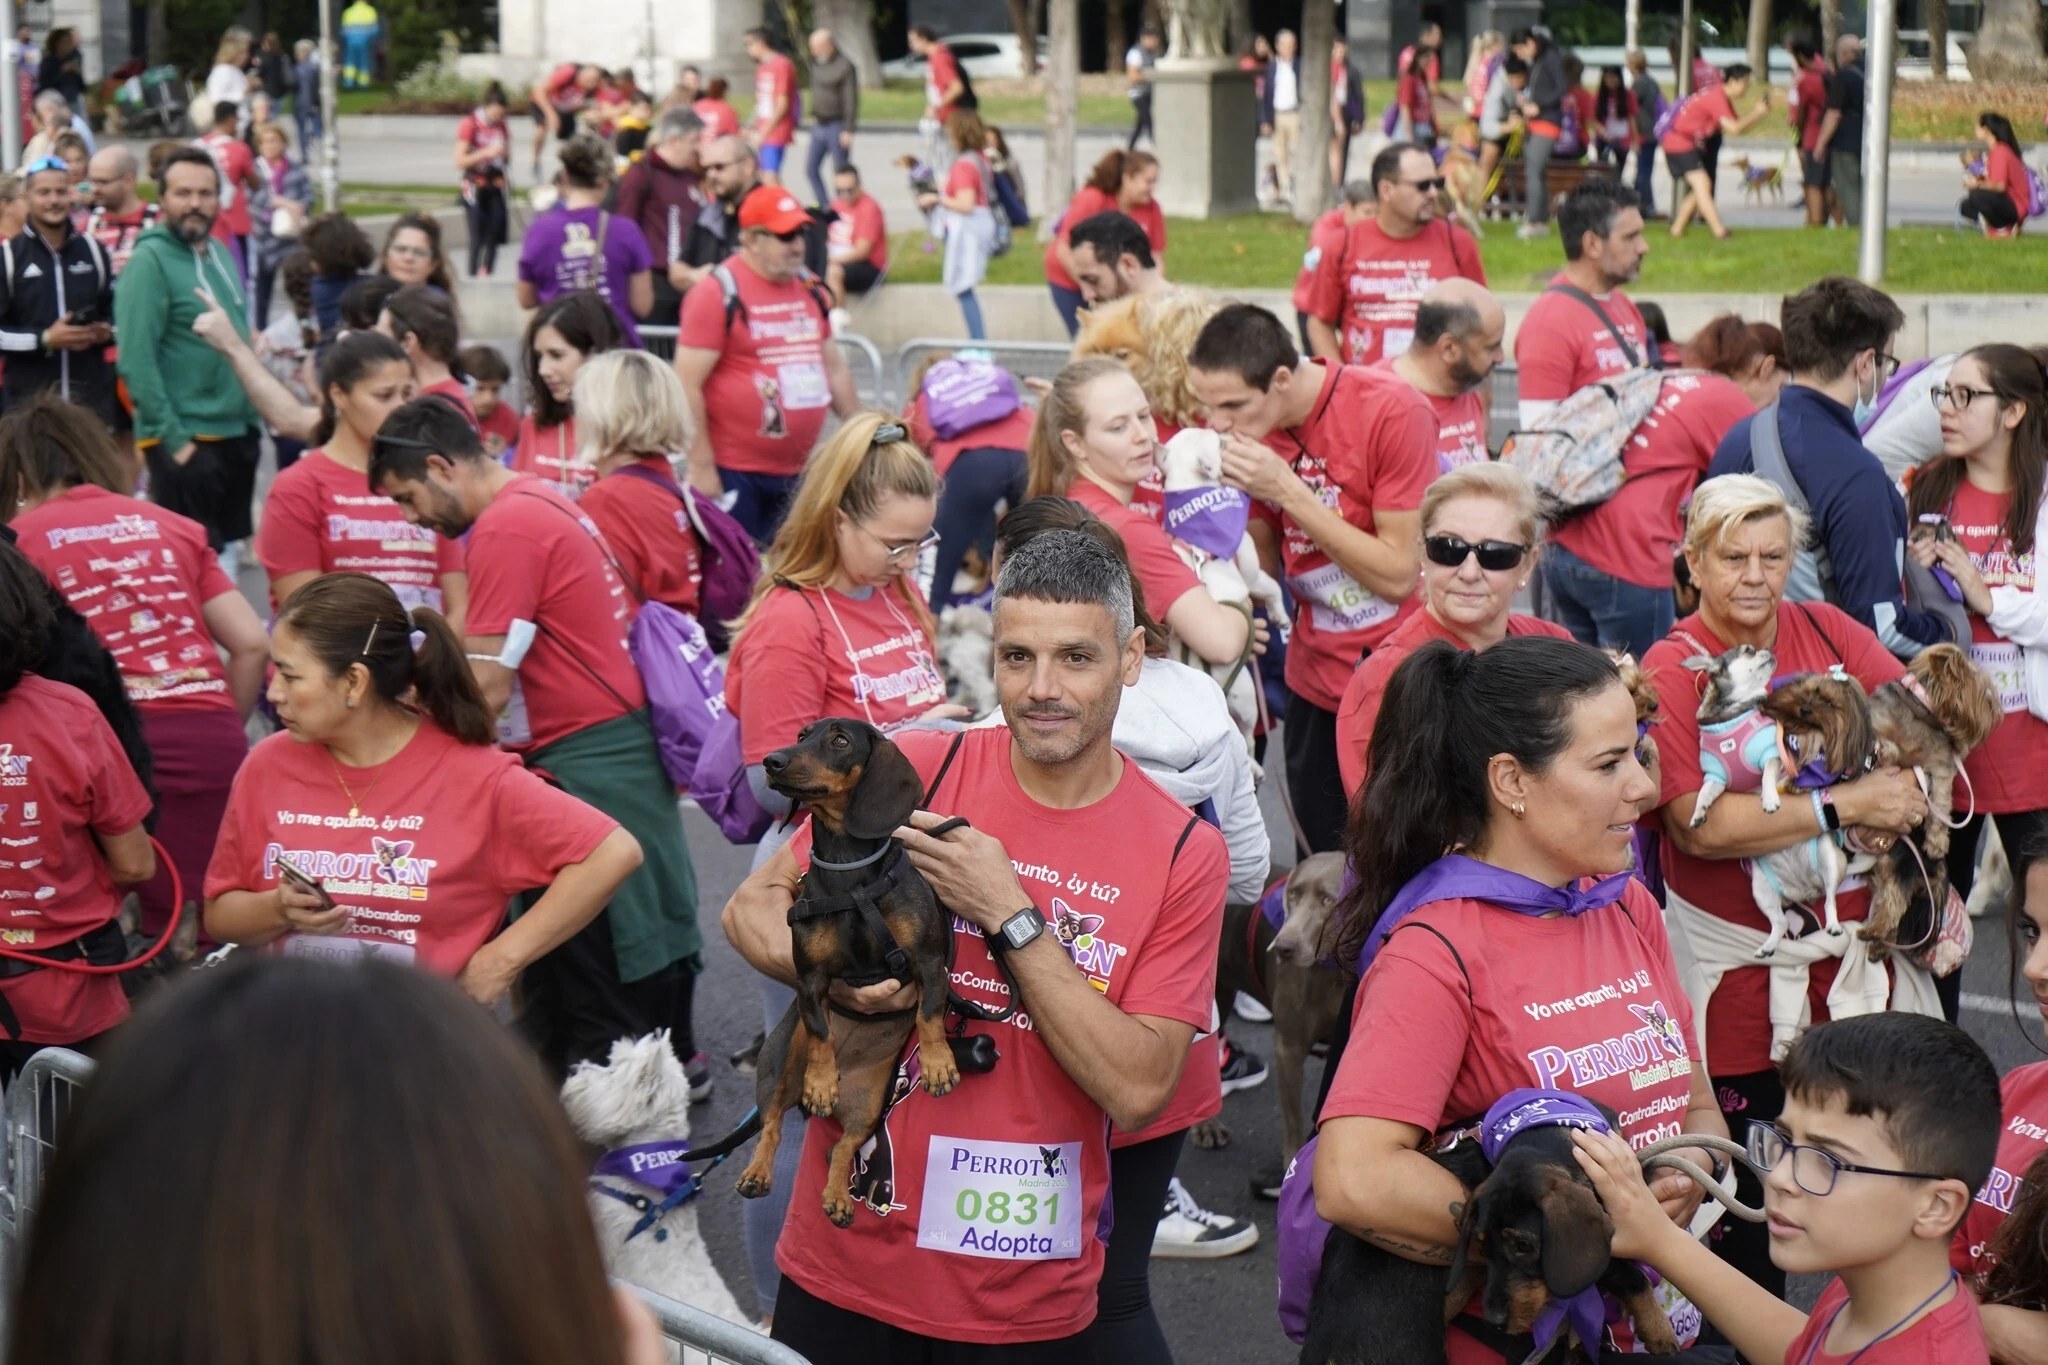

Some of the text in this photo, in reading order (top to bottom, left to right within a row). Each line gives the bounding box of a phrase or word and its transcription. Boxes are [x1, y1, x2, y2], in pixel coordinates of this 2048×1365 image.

[277, 811, 294, 825] Yo
[297, 813, 321, 825] me
[324, 815, 379, 829] apunto,
[381, 815, 398, 831] ¿y
[323, 878, 409, 899] Madrid 2022
[1066, 872, 1088, 895] ¿y
[1090, 881, 1120, 904] tú?
[1523, 1003, 1551, 1021] Yo
[1550, 998, 1576, 1015] me
[1617, 978, 1638, 995] ¿y
[1629, 1061, 1670, 1091] Madrid
[2007, 1115, 2047, 1140] Yo me
[1018, 1178, 1050, 1188] Madrid
[956, 1189, 1060, 1226] 0831
[959, 1226, 1053, 1258] Adopta
